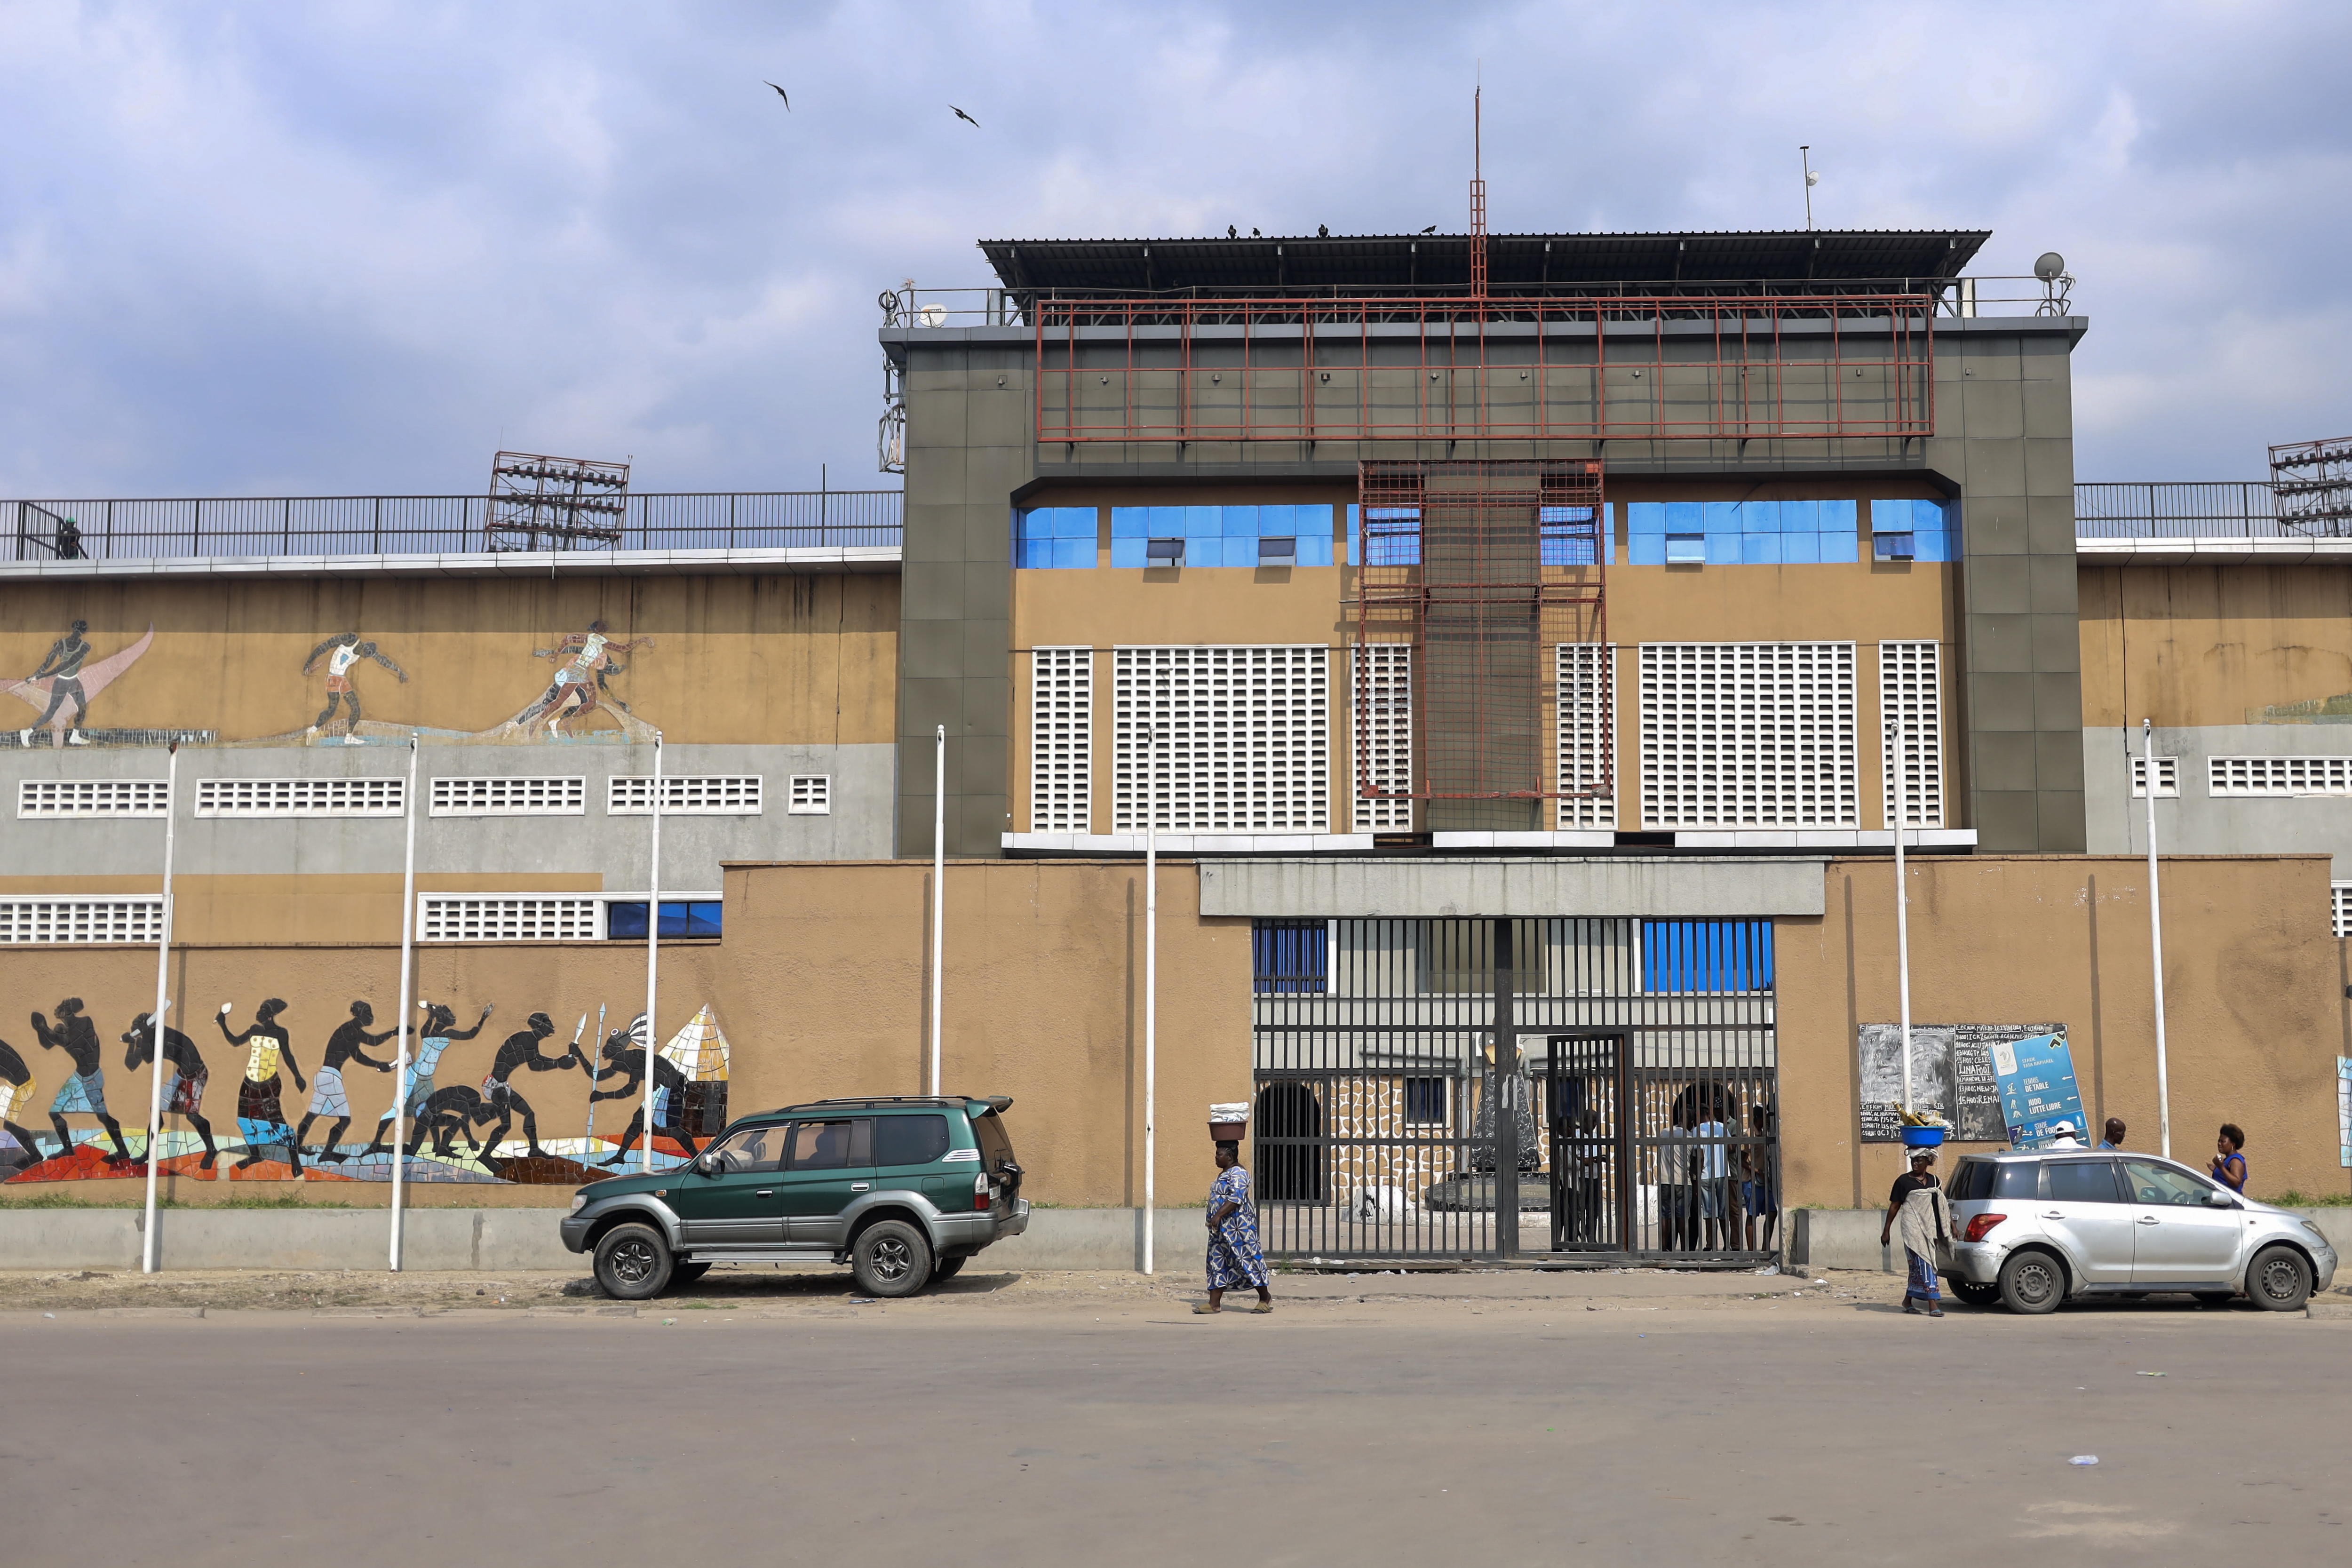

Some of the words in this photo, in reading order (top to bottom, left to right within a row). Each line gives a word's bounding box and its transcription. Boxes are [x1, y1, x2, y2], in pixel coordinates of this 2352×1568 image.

[2025, 1084, 2032, 1092] DE
[2033, 1081, 2049, 1091] TABLE
[2028, 1098, 2042, 1106] JUDO
[2029, 1105, 2046, 1114] LUTTE
[2046, 1101, 2061, 1111] LIBRE
[2034, 1121, 2048, 1130] STADE
